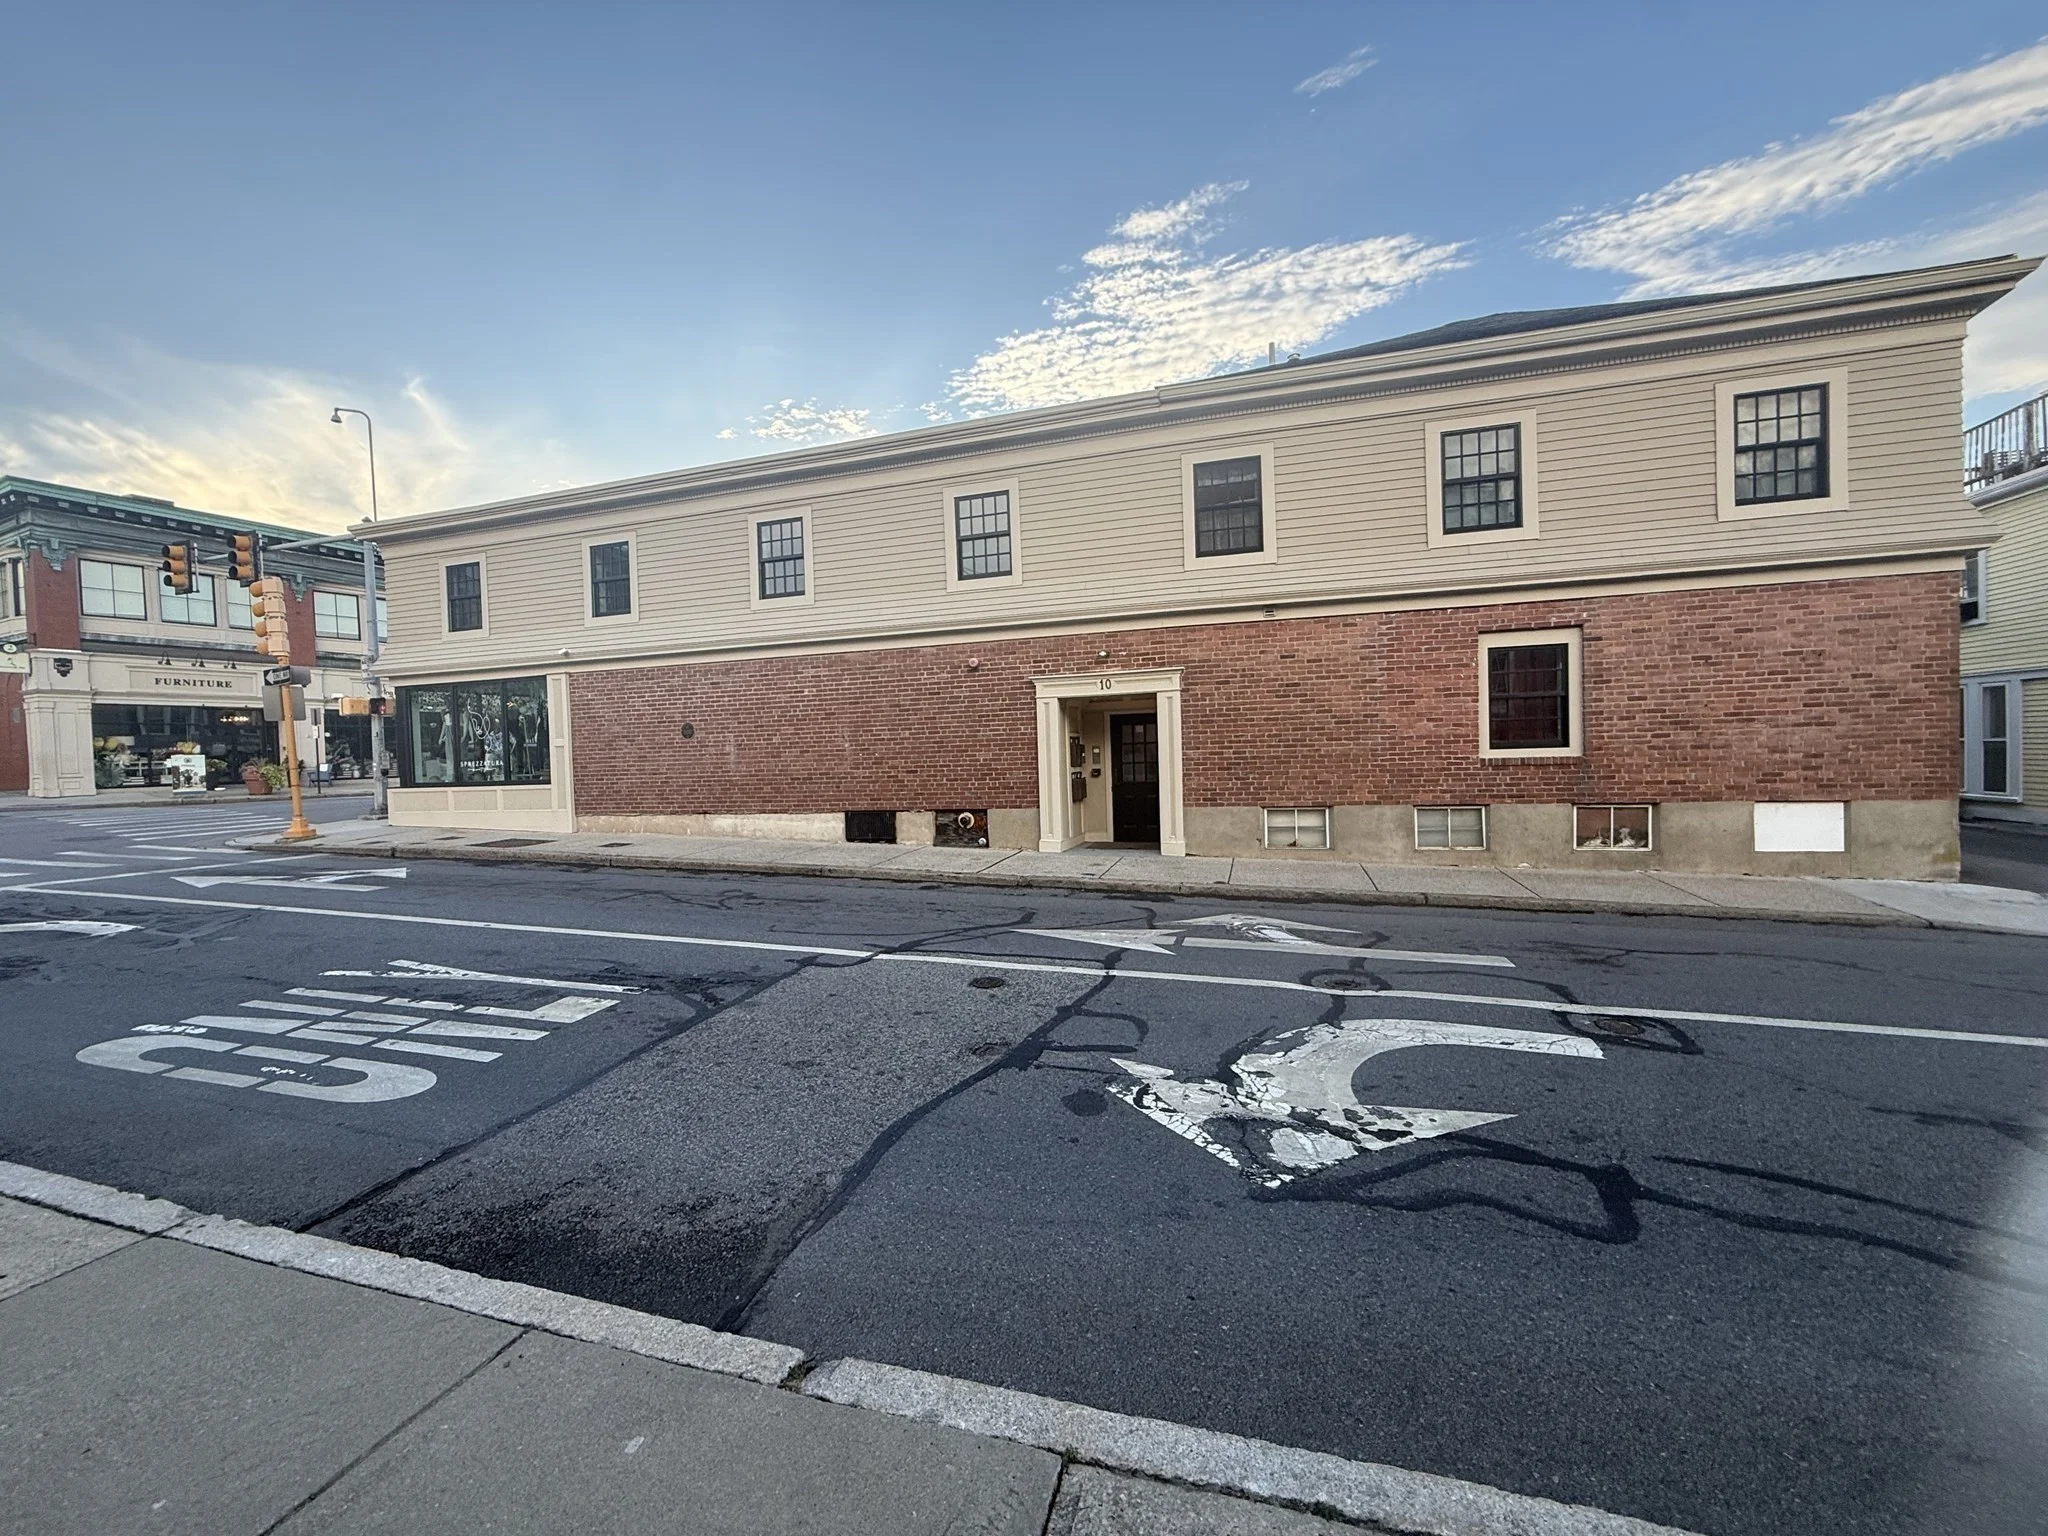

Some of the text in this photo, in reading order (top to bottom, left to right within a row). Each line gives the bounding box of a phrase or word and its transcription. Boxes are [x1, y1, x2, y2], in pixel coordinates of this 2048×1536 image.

[154, 677, 233, 688] FURNITURE
[1099, 678, 1112, 690] 10
[75, 959, 651, 1103] ONLY
